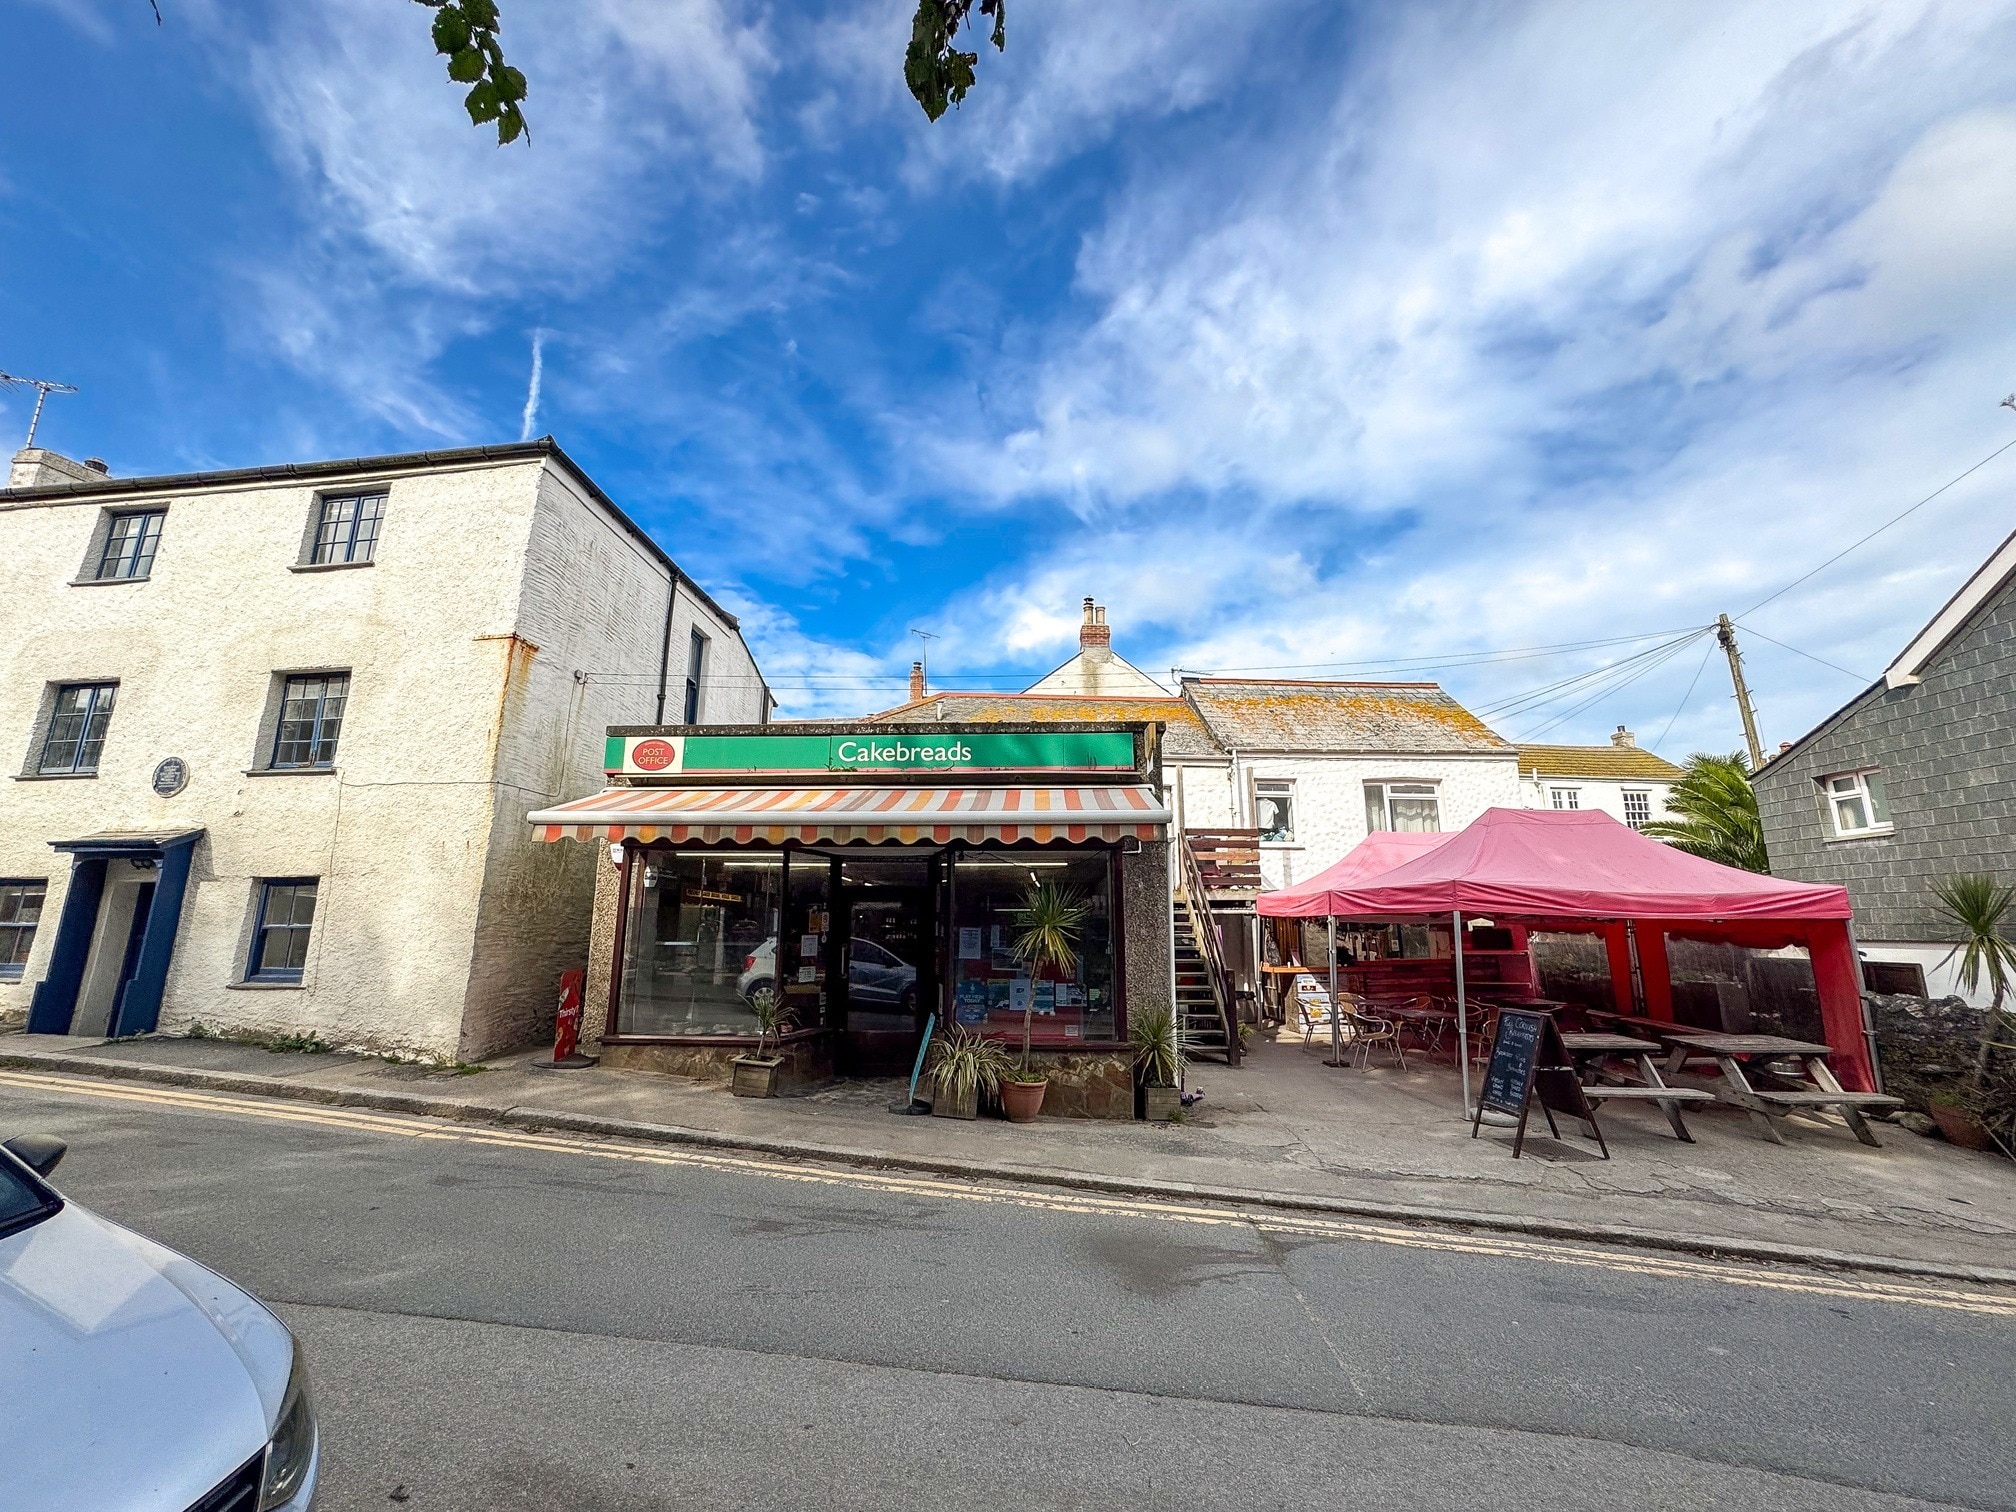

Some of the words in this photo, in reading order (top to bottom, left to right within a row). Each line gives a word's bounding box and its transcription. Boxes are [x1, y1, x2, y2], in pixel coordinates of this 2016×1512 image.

[642, 748, 665, 756] POST
[838, 741, 972, 762] Cakebreads
[638, 756, 669, 765] OFFICE
